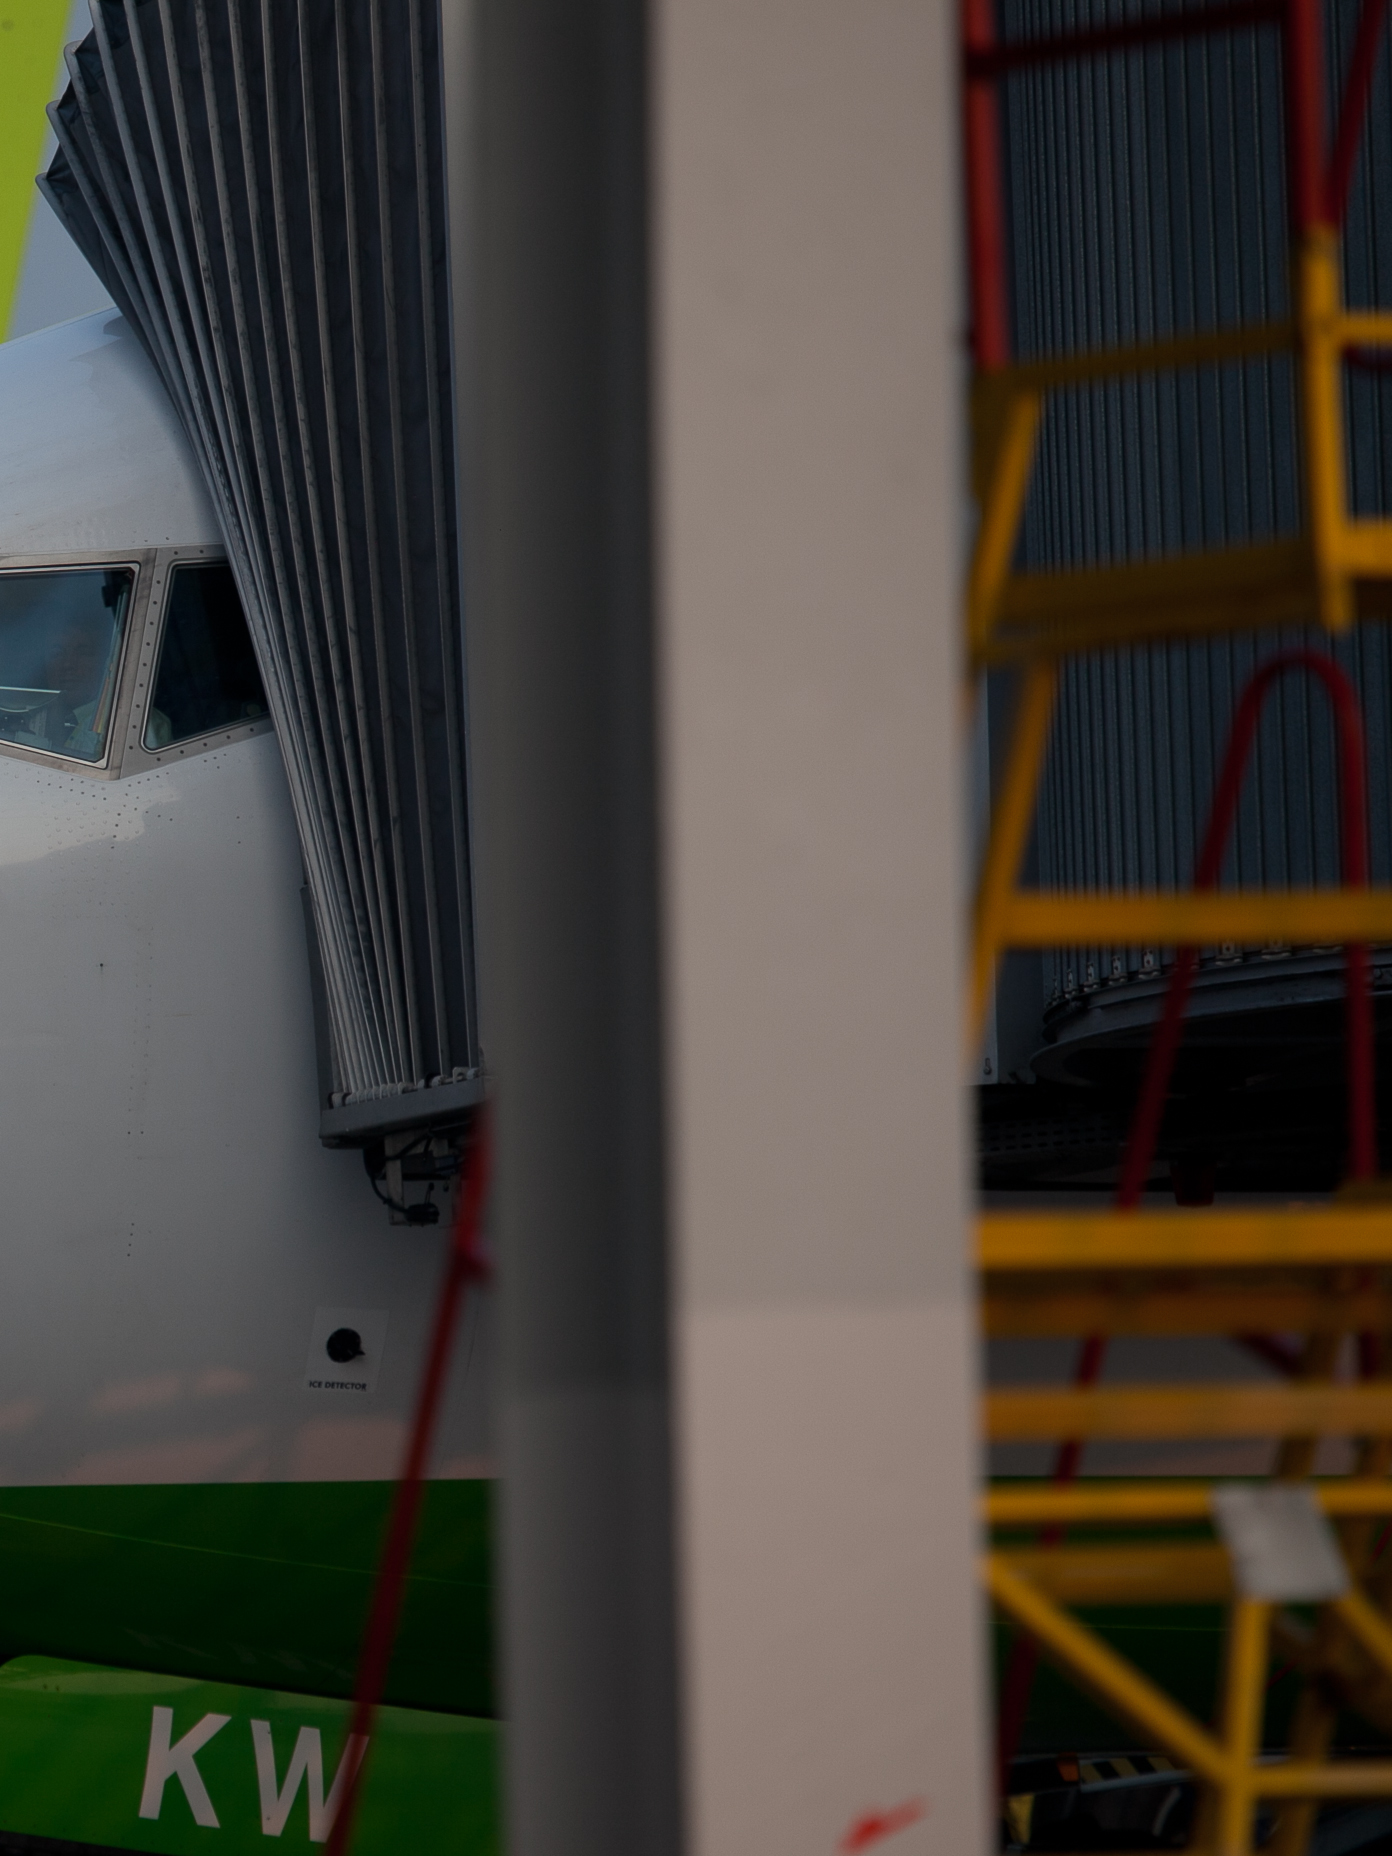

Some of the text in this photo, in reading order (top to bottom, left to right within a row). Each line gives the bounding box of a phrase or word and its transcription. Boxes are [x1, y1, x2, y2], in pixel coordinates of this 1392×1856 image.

[309, 1381, 367, 1391] ICE DETECTOR
[138, 1705, 370, 1843] KW
